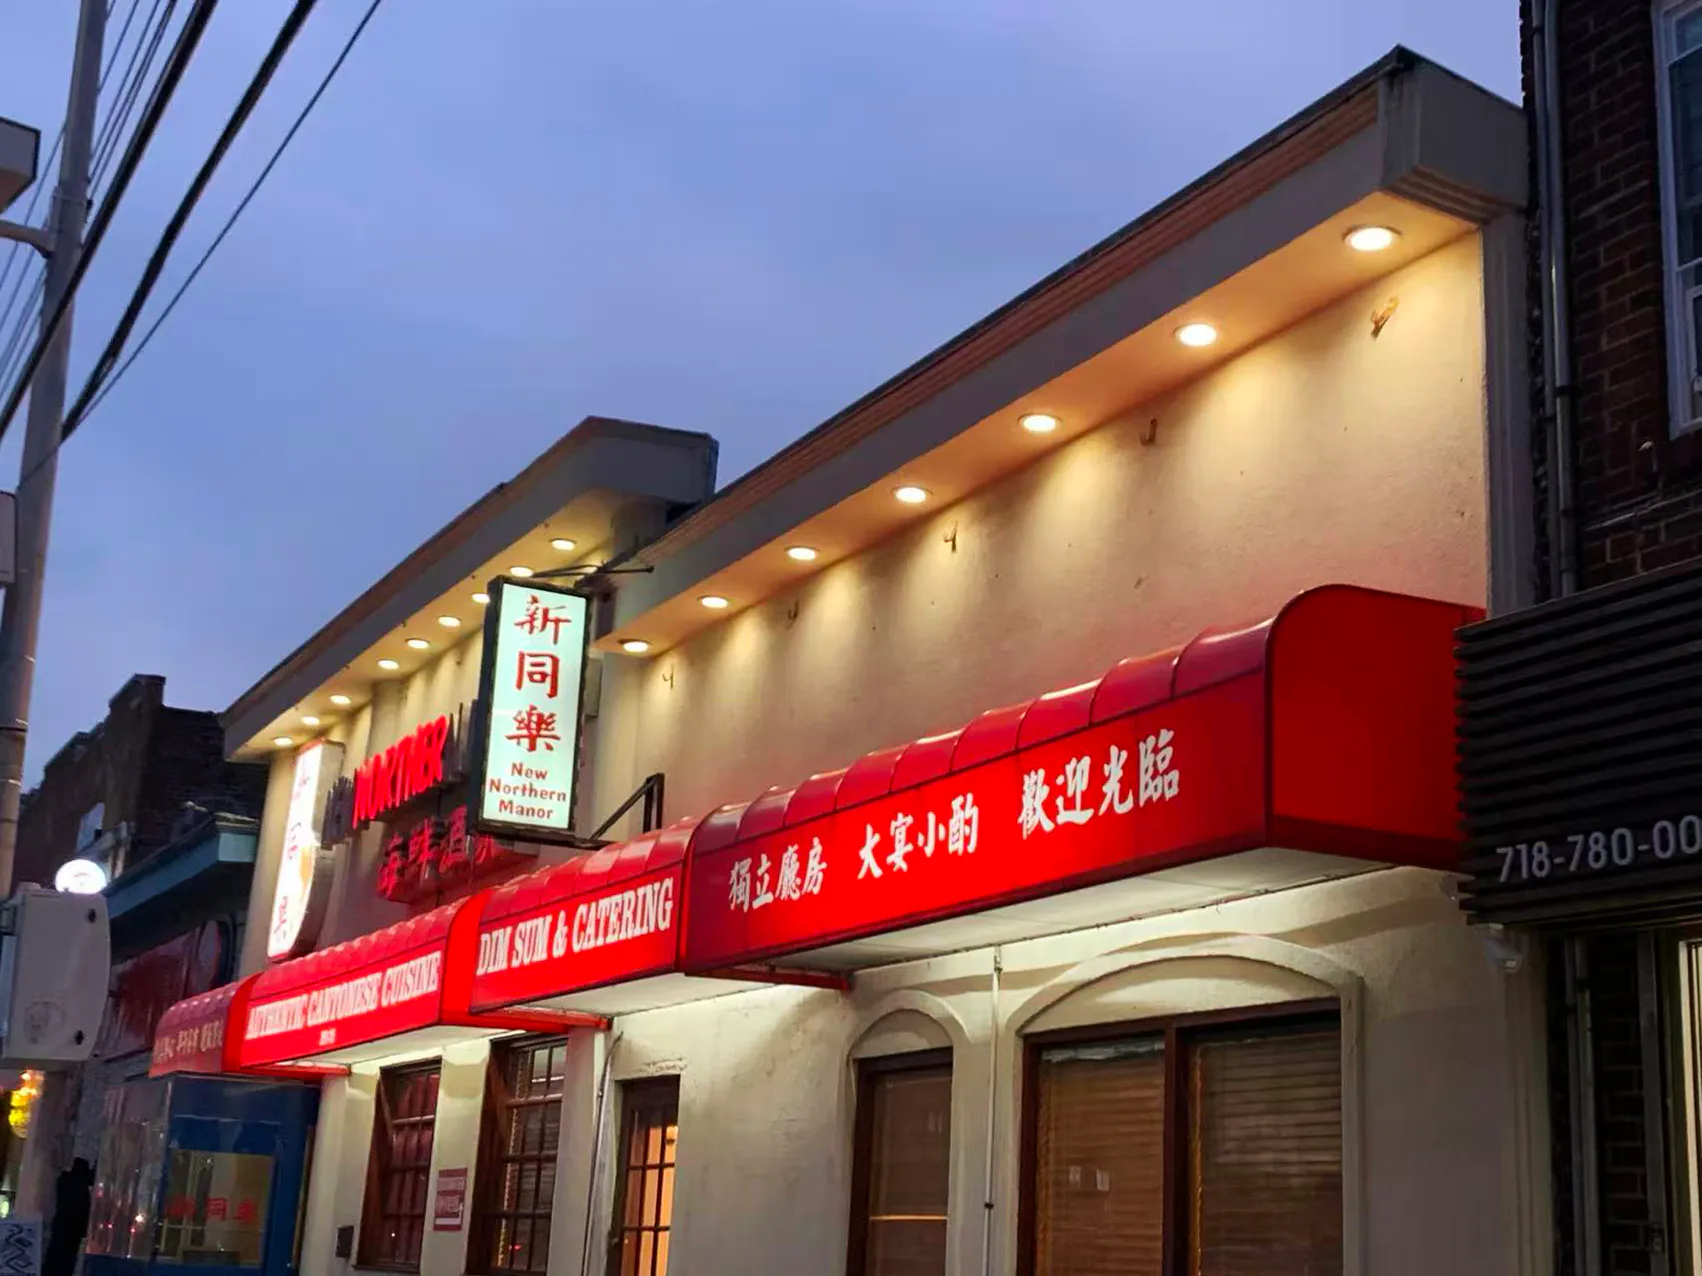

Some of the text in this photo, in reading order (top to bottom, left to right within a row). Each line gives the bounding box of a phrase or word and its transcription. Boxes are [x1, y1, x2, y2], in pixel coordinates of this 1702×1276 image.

[505, 594, 571, 752] 新同樂
[488, 778, 567, 801] Northern
[498, 799, 554, 819] Manor
[510, 762, 548, 780] New
[728, 728, 1180, 912] 獨立廳房 大宴小酌 歡迎光臨
[476, 877, 674, 976] DIM SUM & CATERING
[306, 972, 383, 1027] CANTONESE
[381, 950, 442, 1007] CUISINE
